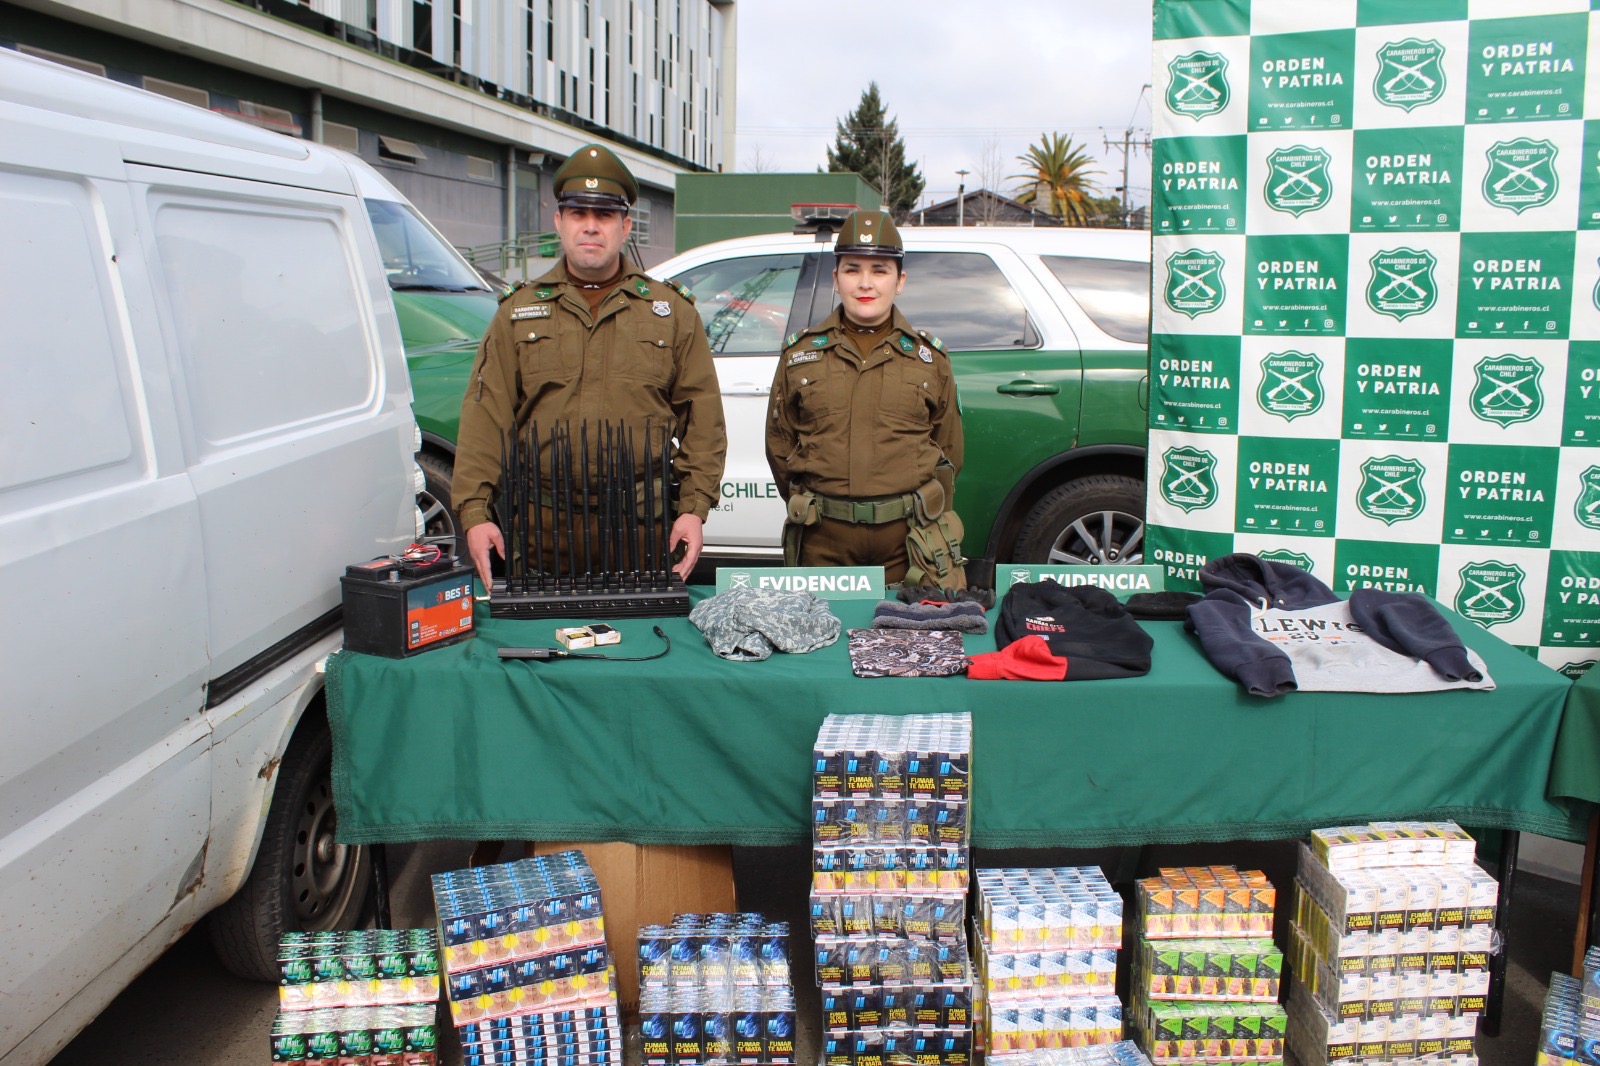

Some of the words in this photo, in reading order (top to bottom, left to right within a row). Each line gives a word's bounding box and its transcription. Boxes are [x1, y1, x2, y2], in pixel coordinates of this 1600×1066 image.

[1483, 42, 1552, 58] ORDEN
[1263, 57, 1324, 72] ORDEN
[1482, 64, 1494, 76] Y
[1501, 59, 1574, 75] PATRIA
[1262, 77, 1272, 88] Y
[1280, 73, 1343, 88] PATRIA
[1488, 88, 1562, 98] www.carabineros.cl
[1268, 100, 1333, 108] www.carabineros.cl
[1164, 161, 1220, 174] ORDEN
[1366, 154, 1431, 168] ORDEN
[1163, 179, 1172, 191] Y
[1178, 177, 1238, 190] PATRIA
[1366, 173, 1376, 185] Y
[1384, 171, 1450, 184] PATRIA
[1168, 203, 1230, 211] www.carabineros.cl
[1258, 261, 1318, 273] ORDEN
[1474, 260, 1540, 272] ORDEN
[1258, 278, 1268, 289] Y
[1274, 278, 1336, 289] PATRIA
[1472, 277, 1484, 290] Y
[1491, 277, 1560, 289] PATRIA
[1160, 359, 1212, 372] ORDEN
[1358, 364, 1421, 377] ORDEN
[1160, 374, 1168, 386] Y
[1174, 376, 1230, 388] PATRIA
[1357, 381, 1368, 392] Y
[1375, 381, 1440, 394] PATRIA
[1580, 386, 1592, 398] Y
[1250, 462, 1309, 475] ORDEN
[1461, 470, 1526, 484] ORDEN
[722, 482, 777, 498] CHILE
[1250, 478, 1260, 488] Y
[1266, 478, 1327, 492] PATRIA
[1460, 487, 1470, 498] Y
[1477, 488, 1544, 502] PATRIA
[1154, 549, 1206, 566] ORDEN
[1347, 564, 1408, 578] ORDEN
[760, 576, 871, 591] EVIDENCIA
[1039, 574, 1150, 589] EVIDENCIA
[1346, 580, 1356, 592] Y
[1363, 580, 1424, 594] PATRIA
[445, 585, 470, 600] BESTE
[1560, 592, 1571, 603] Y
[1026, 618, 1048, 626] KANSAS
[1026, 622, 1066, 632] CHIEFS
